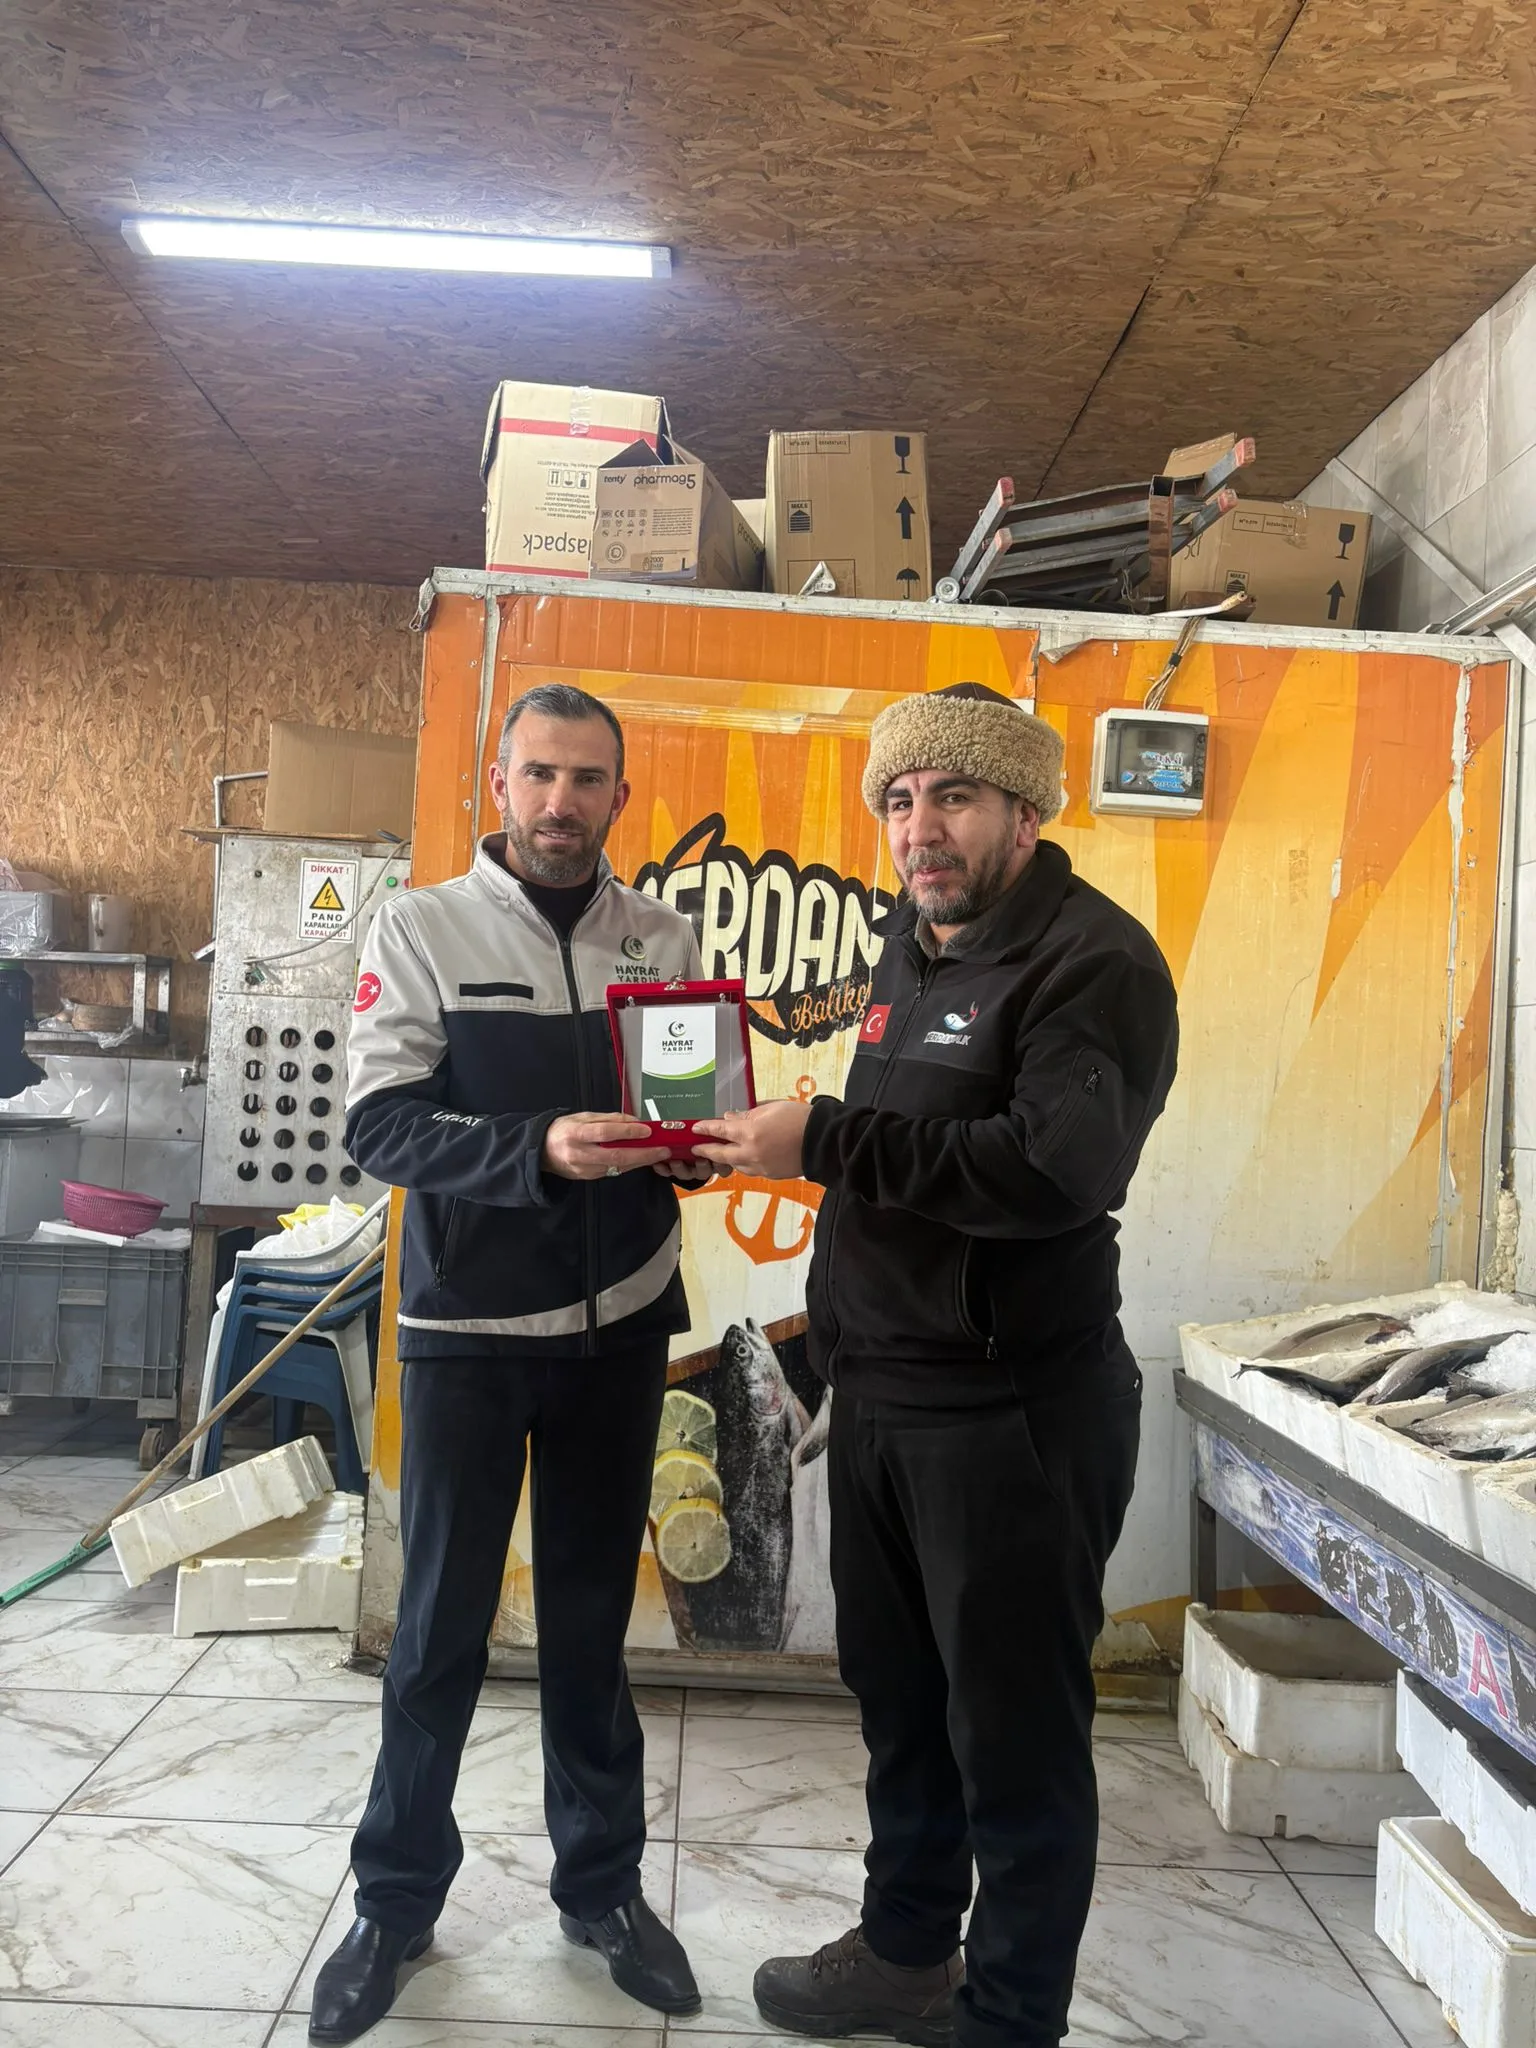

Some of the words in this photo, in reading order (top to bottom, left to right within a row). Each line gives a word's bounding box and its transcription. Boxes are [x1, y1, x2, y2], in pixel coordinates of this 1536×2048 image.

[310, 865, 344, 874] DİKKAT
[311, 912, 343, 921] PANO
[615, 965, 660, 976] HAYRAT
